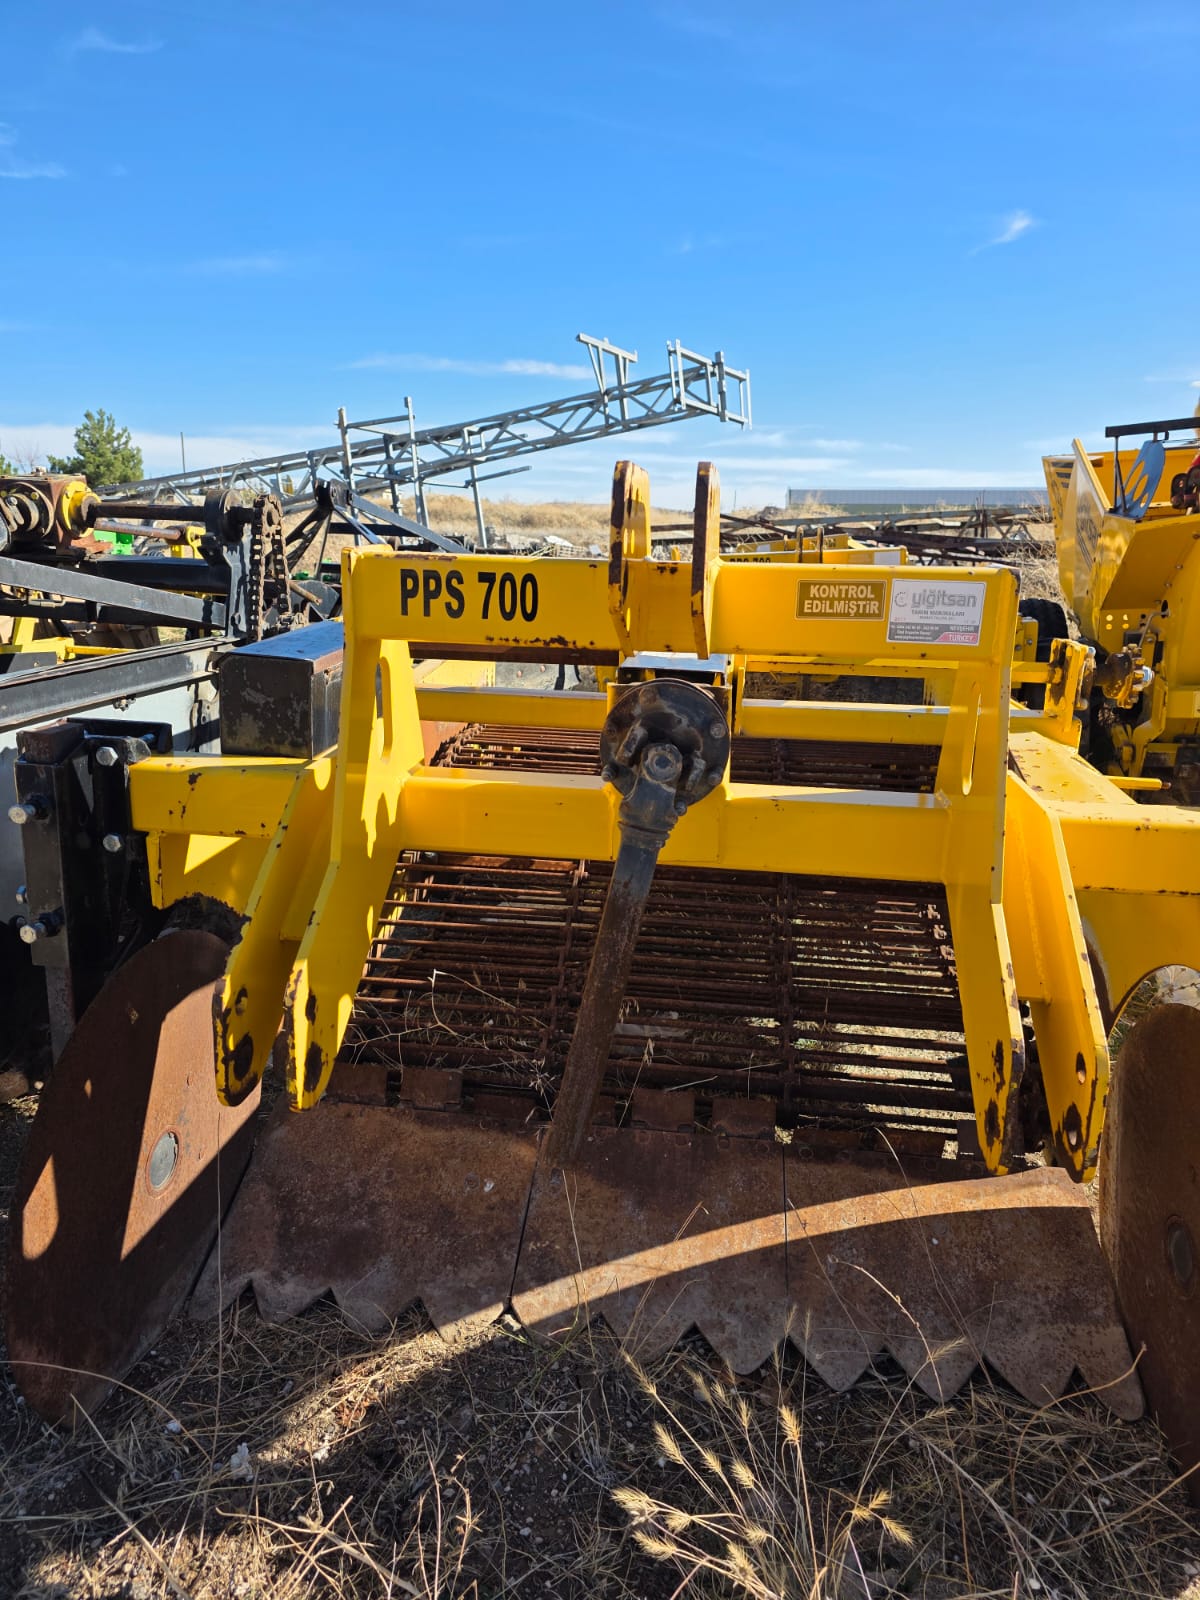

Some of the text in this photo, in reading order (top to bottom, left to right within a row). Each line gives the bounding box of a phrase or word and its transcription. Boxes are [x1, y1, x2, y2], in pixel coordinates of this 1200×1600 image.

[400, 568, 539, 622] PPS 700
[809, 584, 875, 599] KONTROL
